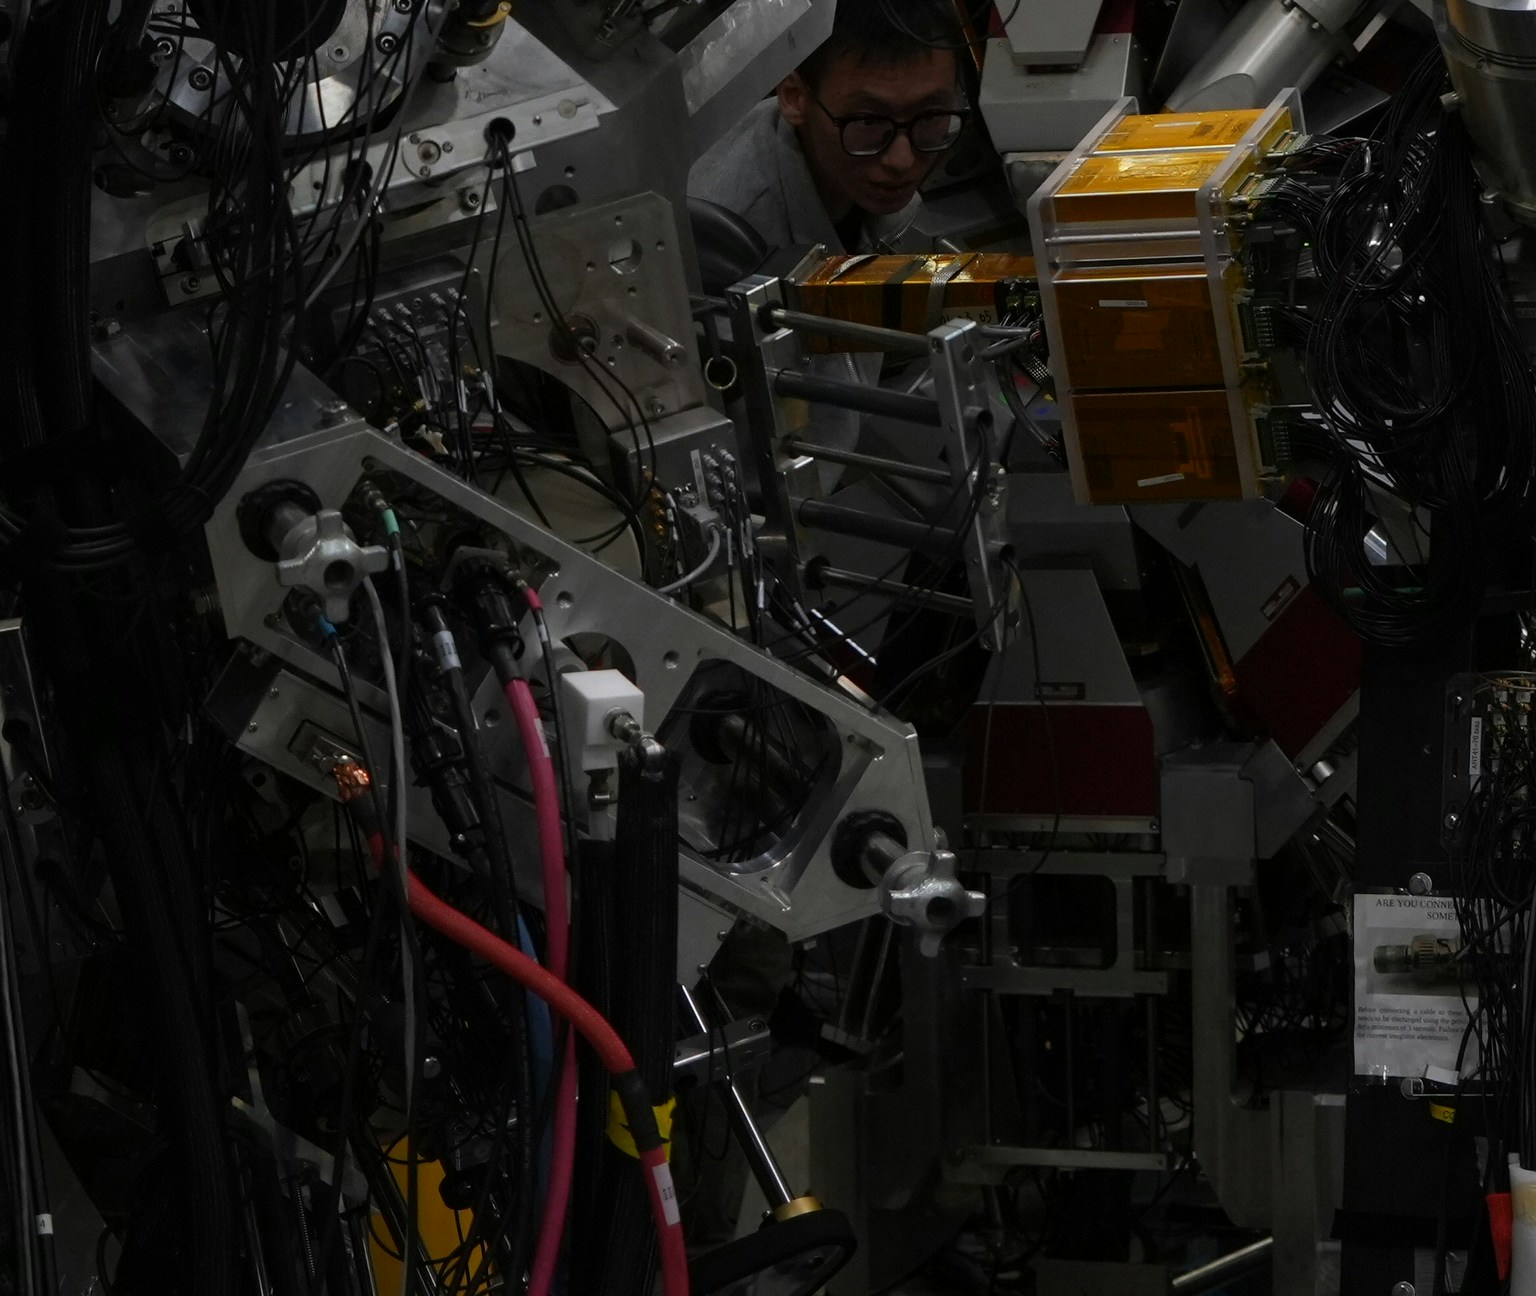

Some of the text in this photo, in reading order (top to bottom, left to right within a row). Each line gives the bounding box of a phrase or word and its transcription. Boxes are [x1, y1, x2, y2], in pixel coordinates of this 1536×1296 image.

[1375, 898, 1455, 910] ARE YOU CONNE
[1426, 911, 1458, 921] SOMET
